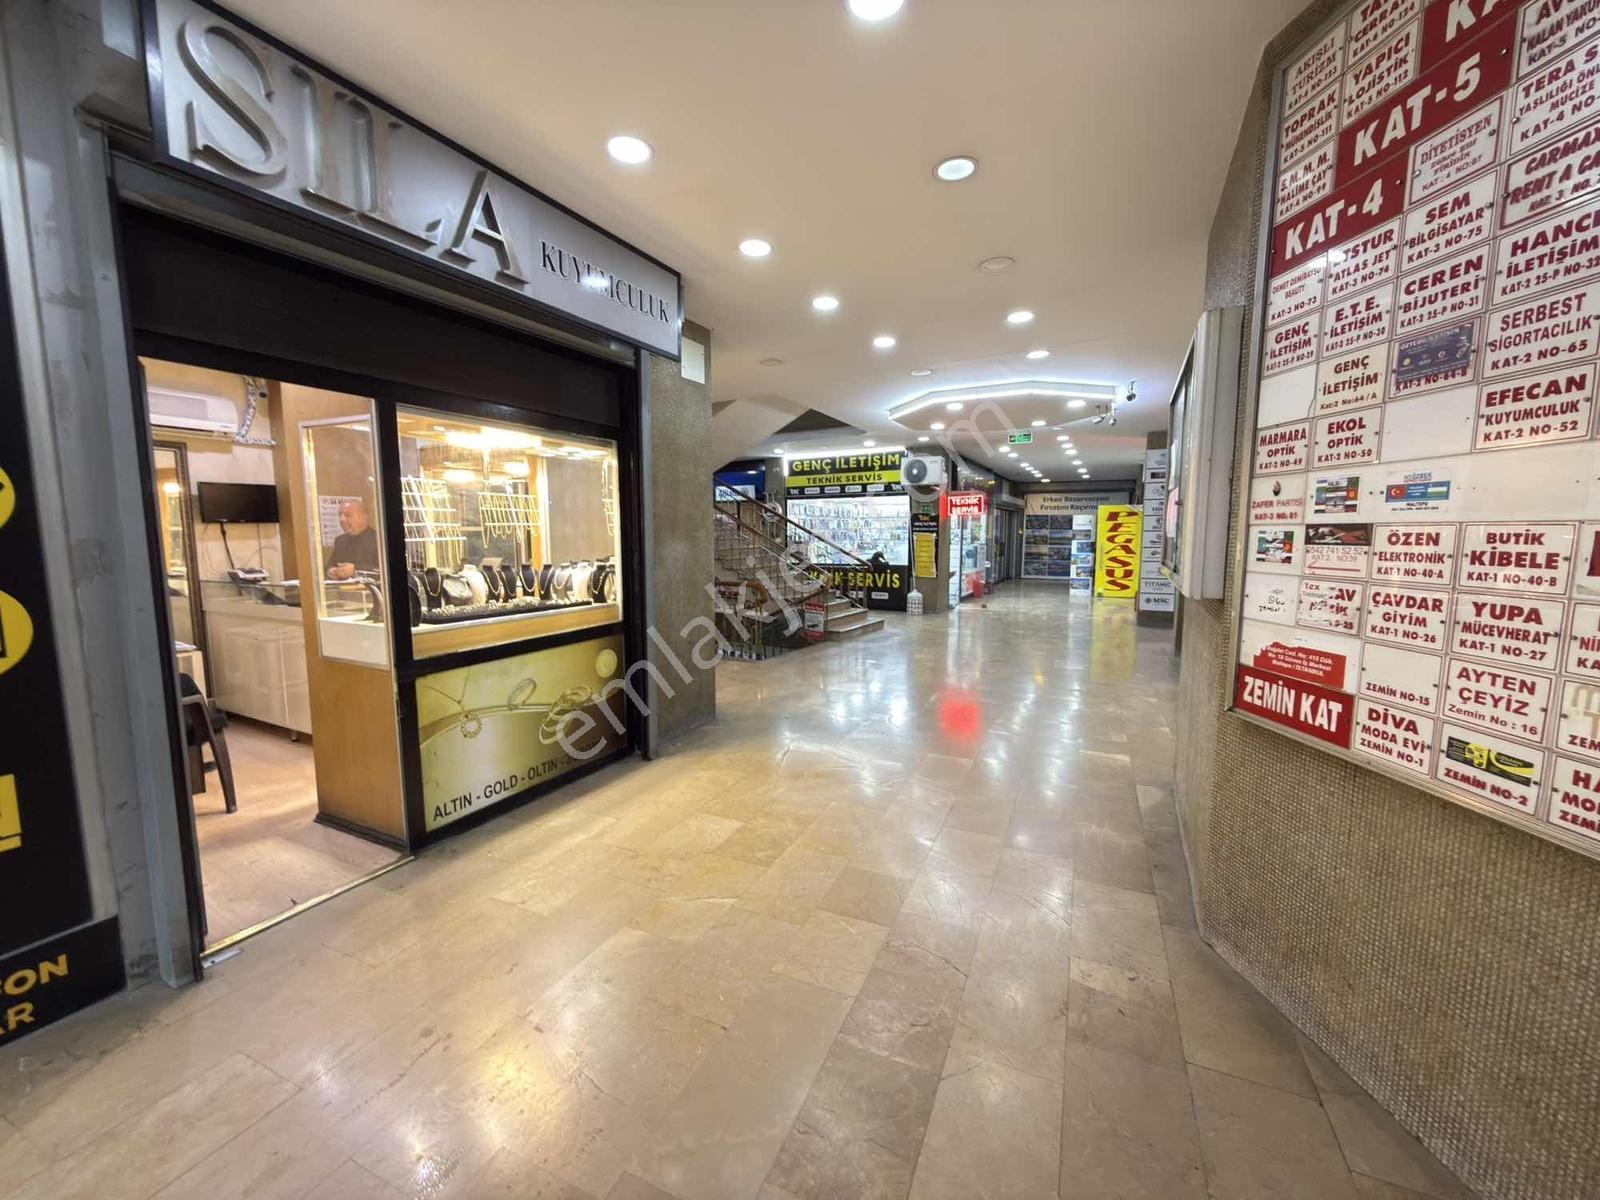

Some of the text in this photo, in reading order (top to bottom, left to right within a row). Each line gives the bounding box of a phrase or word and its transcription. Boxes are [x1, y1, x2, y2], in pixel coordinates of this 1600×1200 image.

[1353, 32, 1410, 85] YAPICI
[1348, 52, 1409, 105] LOJİSTİK
[1522, 59, 1576, 99] TERA
[1285, 89, 1337, 138] TOPRAK
[1354, 52, 1480, 166] KAT-5
[1571, 94, 1600, 115] NO-
[1510, 170, 1557, 205] RENT
[1559, 163, 1573, 183] A
[1578, 150, 1600, 175] CA
[1285, 178, 1383, 260] KAT-4
[1425, 192, 1470, 225] SEM
[1409, 207, 1484, 249] BİLGİSAYAR
[1407, 225, 1482, 264] KAT-3 NO-75
[1334, 250, 1390, 282] ATLAS JET
[1361, 265, 1389, 284] NO-74
[1404, 255, 1483, 296] CEREN
[1402, 275, 1480, 313] BİJUTERİ
[1501, 281, 1531, 297] KAT-2
[1535, 268, 1560, 286] 25-P
[1450, 296, 1479, 312] NO-31
[1500, 292, 1587, 332] SERBEST
[1274, 322, 1309, 345] GENÇ
[1330, 312, 1382, 338] İLETİŞİM
[1489, 314, 1591, 353] SİGORTACILIK
[1270, 336, 1311, 360] İLETİŞİM
[1491, 339, 1588, 370] KAT-2 NO-65
[1334, 355, 1369, 374] GENÇ
[1322, 371, 1379, 396] İLETİŞİM
[1485, 373, 1587, 408] EFECAN
[1485, 399, 1580, 427] KUYUMCULUK
[1259, 428, 1307, 447] MARMARA
[1327, 417, 1366, 435] EKOL
[1483, 420, 1579, 442] KAT-2 NO-52
[1267, 444, 1295, 458] OPTİK
[1327, 433, 1363, 449] OPTİK
[792, 452, 900, 473] GENÇ İLETİŞİM
[1317, 448, 1373, 463] KAT-2 NO-50
[806, 472, 882, 485] TEKNİK SERVİS
[1252, 499, 1275, 509] ZAFER
[1387, 529, 1440, 547] ÖZEN
[1486, 528, 1545, 546] BUTİK
[1104, 511, 1139, 591] PEGASUS
[1377, 550, 1445, 564] ELEKTRONİK
[1469, 546, 1560, 570] KİBELE
[848, 569, 900, 588] SERVİS
[1376, 566, 1444, 579] KAT-1 NO-40-A
[1467, 570, 1557, 587] KAT-1 NO-40-B
[1372, 591, 1444, 613] ÇAVDAR
[1472, 601, 1543, 625] YUPA
[1382, 611, 1427, 628] GİYİM
[1370, 624, 1436, 643] KAT-1 NO-26
[1461, 620, 1550, 645] MÜCEVHERAT
[1459, 638, 1547, 661] KAT-1 NO-27
[1366, 681, 1430, 706] ZEMİN NO-15
[1457, 667, 1536, 696] AYTEN
[1243, 675, 1342, 733] ZEMİN KAT
[1458, 687, 1529, 717] ÇEYİZ
[1367, 707, 1419, 736] DİVA
[1448, 703, 1486, 721] Zemin
[1490, 714, 1508, 727] No
[1520, 723, 1538, 736] 16
[1361, 724, 1426, 754] MODA EVİ
[1360, 737, 1424, 767] ZEMİN NO-1
[433, 792, 472, 821] ALTIN
[483, 775, 518, 799] GOLD
[527, 758, 558, 780] OLTIN
[1444, 768, 1529, 807] ZEMİN NO-2
